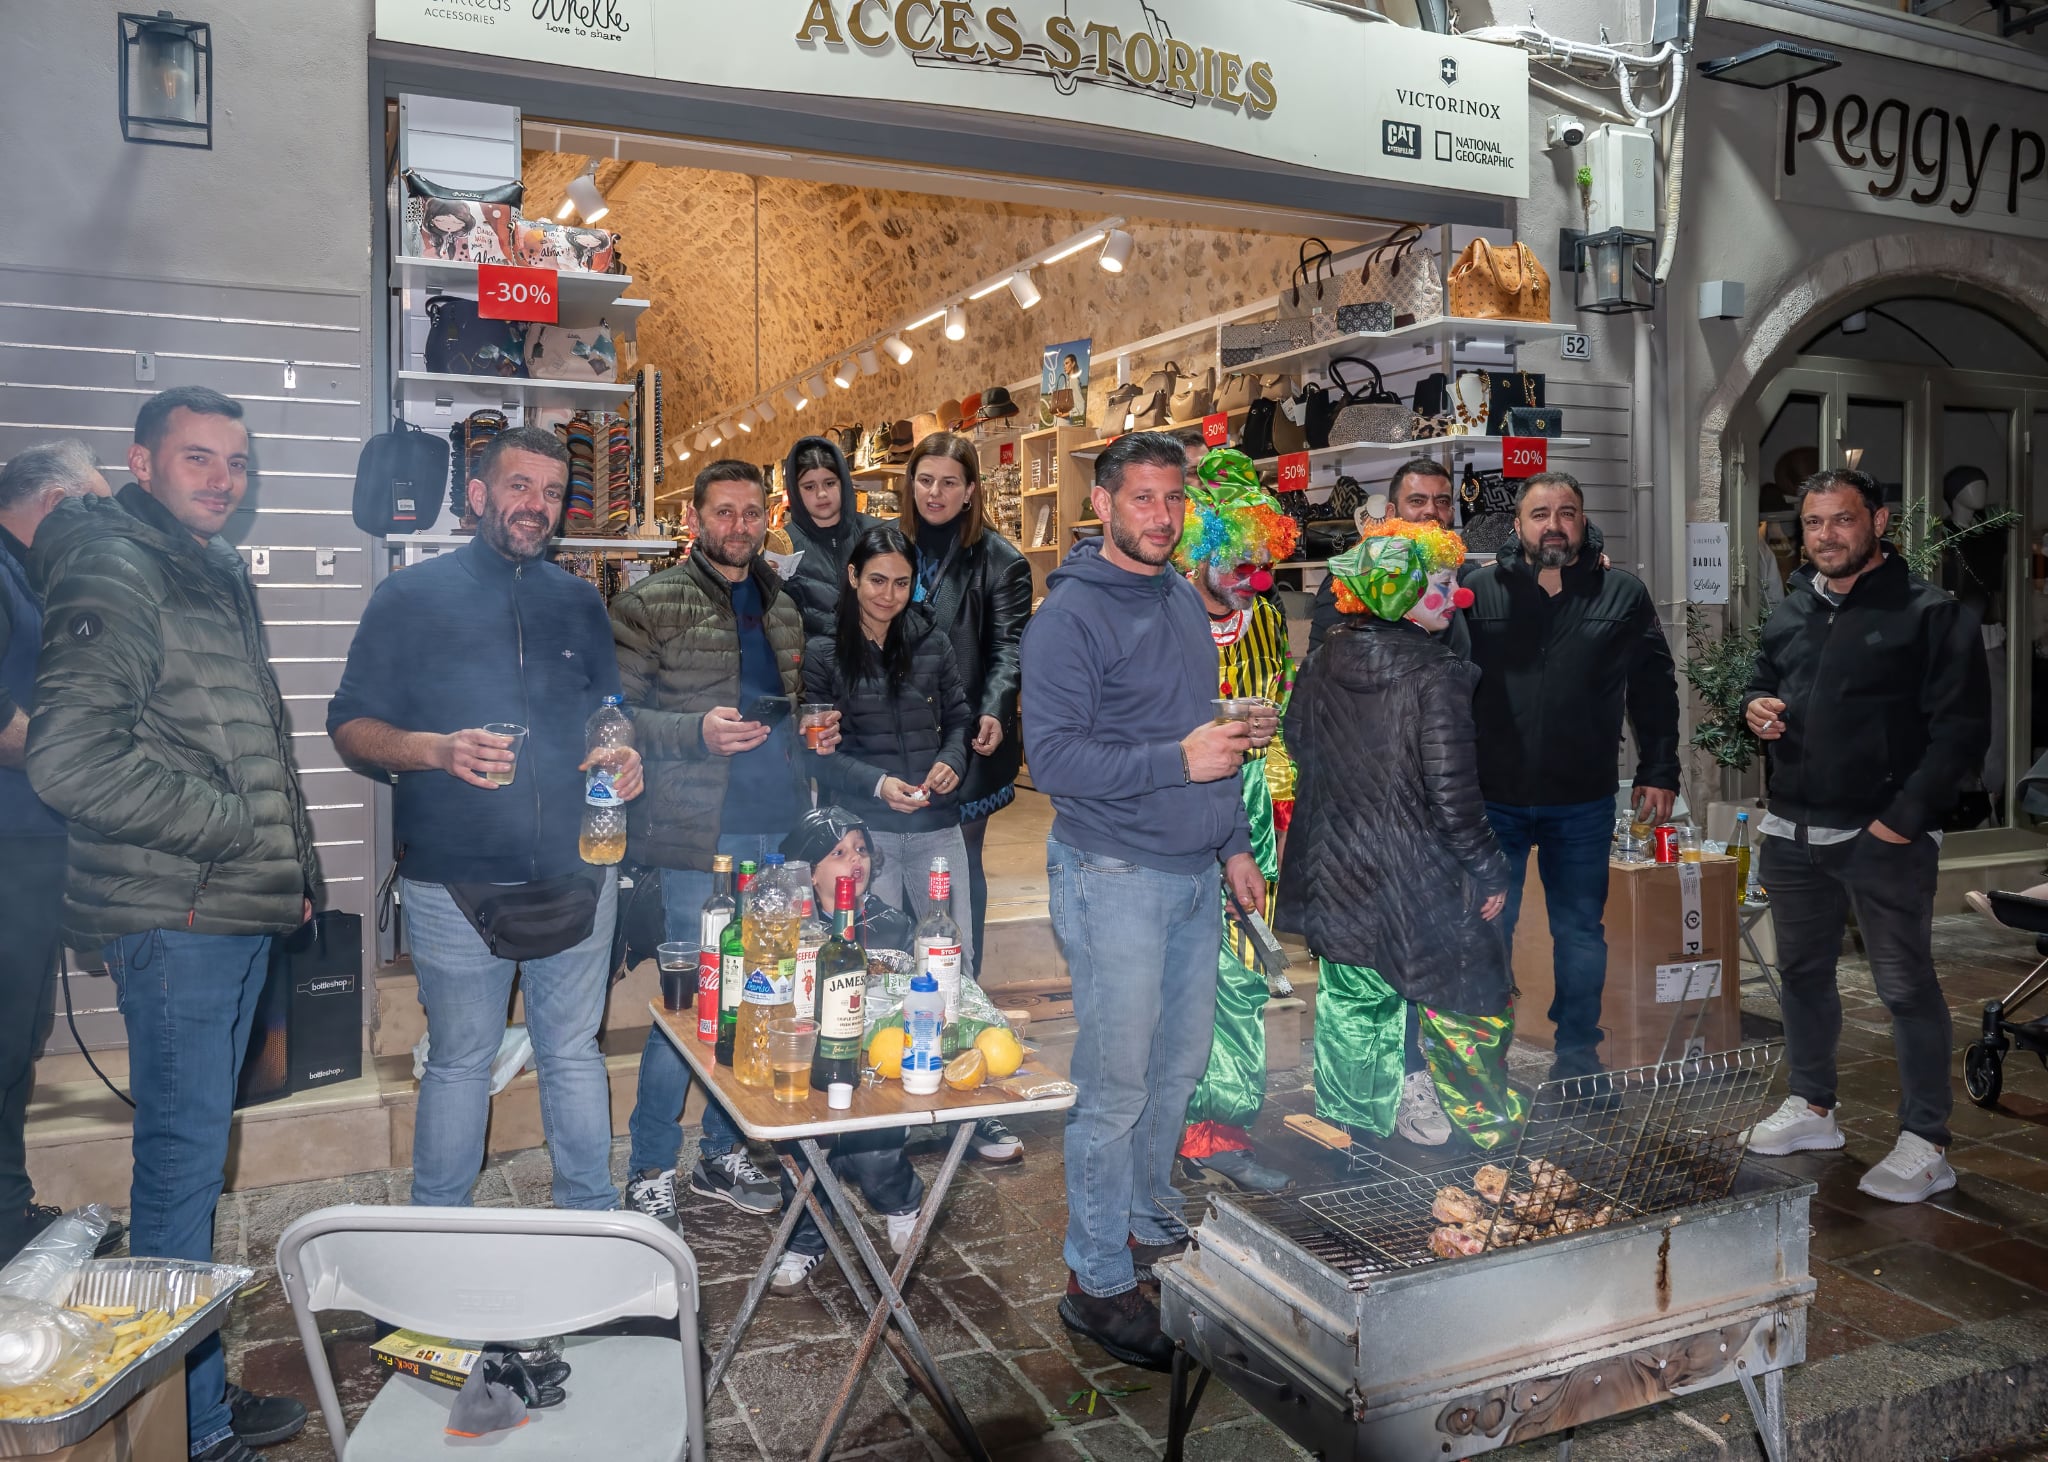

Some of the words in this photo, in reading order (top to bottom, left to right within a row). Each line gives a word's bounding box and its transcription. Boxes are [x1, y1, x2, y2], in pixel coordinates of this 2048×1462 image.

[424, 7, 495, 25] ACCESSORIES
[546, 22, 570, 34] Love
[575, 27, 587, 36] to
[590, 29, 622, 41] share
[796, 0, 1024, 64] ACCES
[1042, 15, 1278, 115] STORIES
[1396, 88, 1501, 120] VICTORINOX
[1387, 124, 1416, 148] CAT
[1455, 136, 1502, 154] NATIONAL
[1455, 150, 1515, 168] GEOGRAPHIC
[486, 282, 551, 305] -30%
[1566, 336, 1585, 354] 52
[1205, 422, 1225, 437] -50%
[1507, 449, 1543, 465] -20%
[1280, 463, 1306, 480] -50%
[311, 979, 348, 991] bottleshop
[829, 975, 867, 992] JAMES
[309, 1067, 341, 1080] bottleshop
